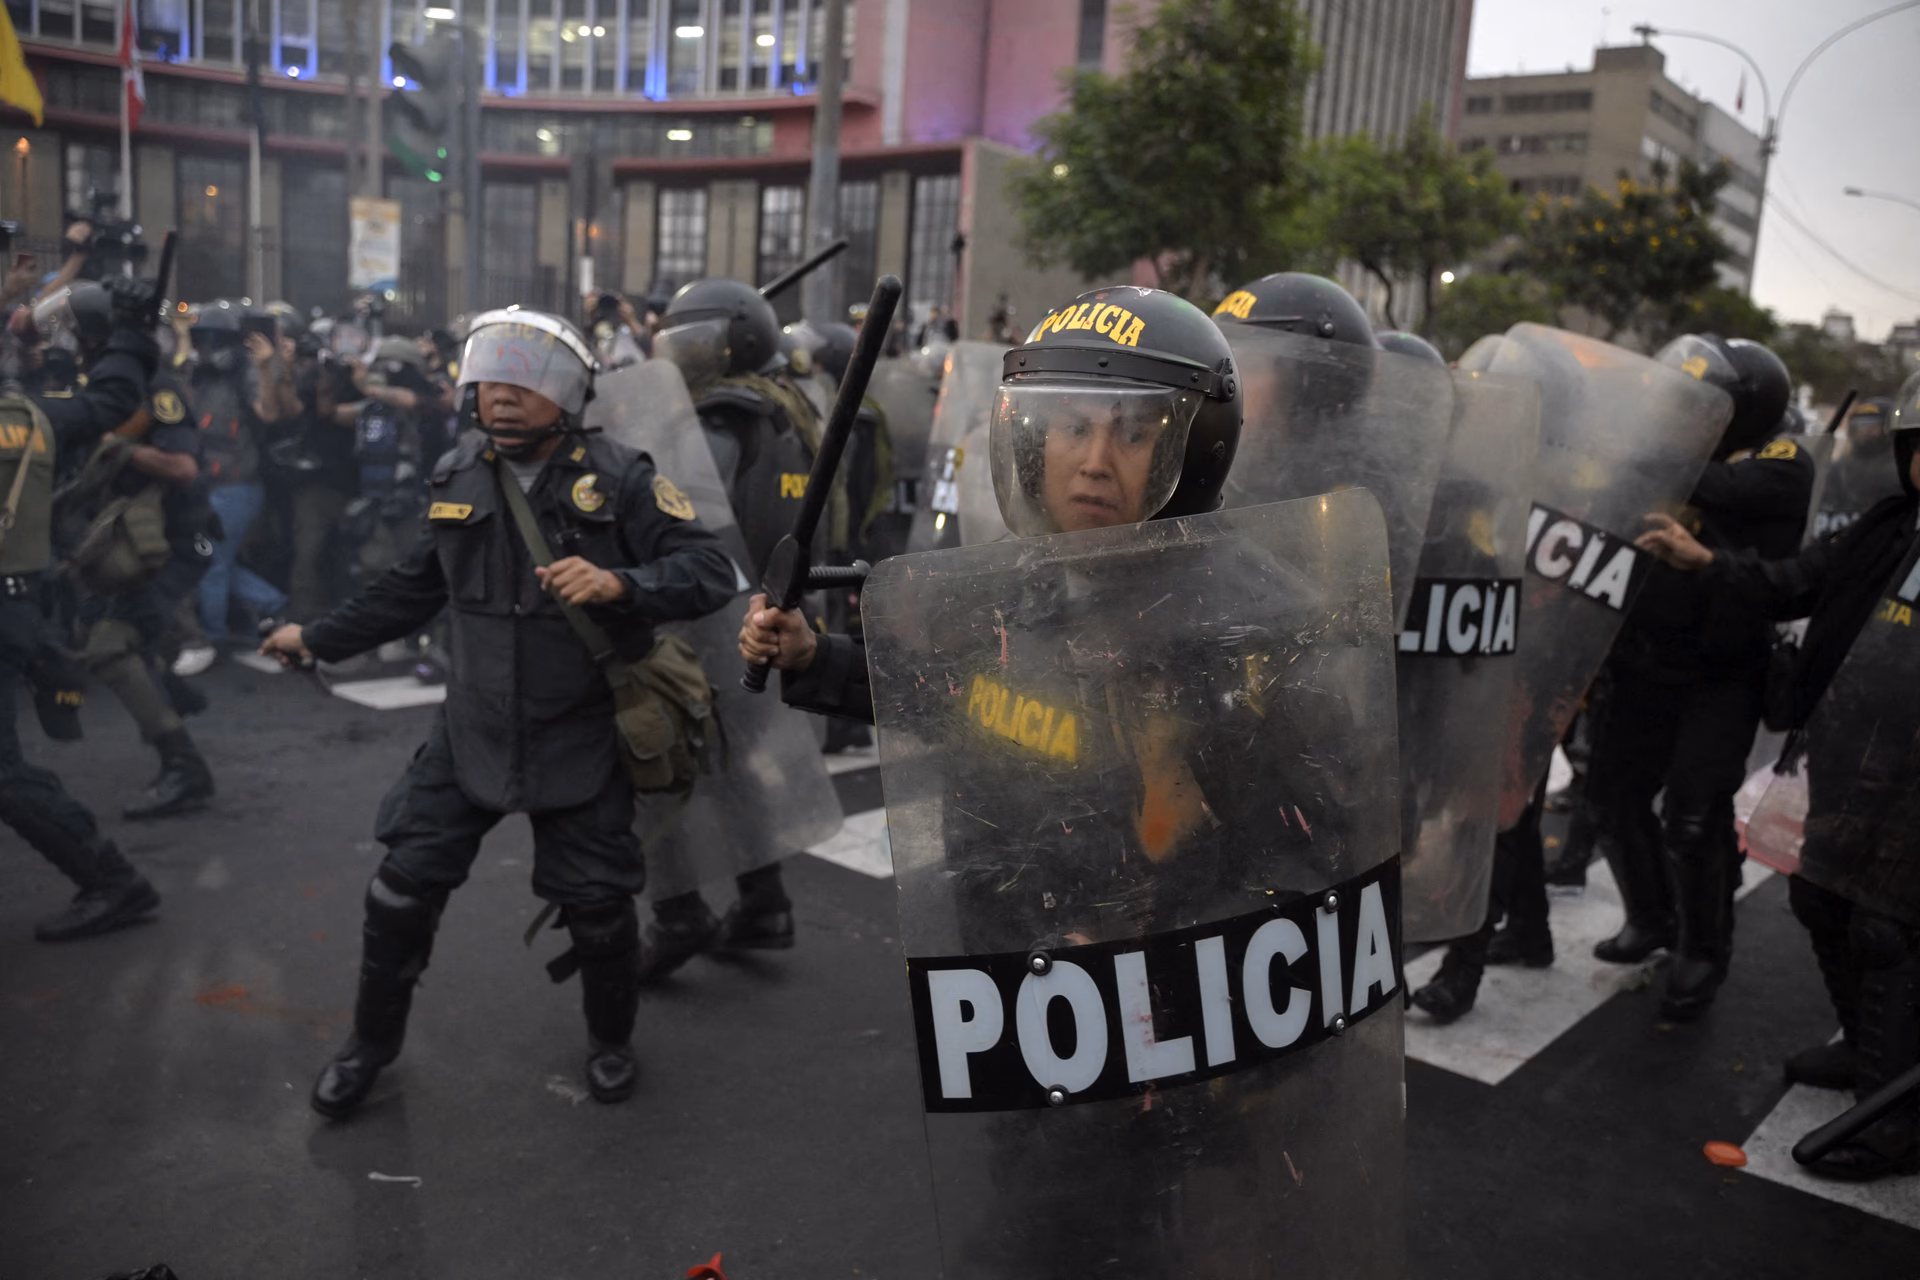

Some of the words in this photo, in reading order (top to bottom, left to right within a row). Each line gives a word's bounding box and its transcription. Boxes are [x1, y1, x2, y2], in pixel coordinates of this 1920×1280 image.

[1034, 302, 1146, 347] POLICIA
[968, 673, 1077, 763] POLICIA
[927, 881, 1397, 1098] POLICIA
